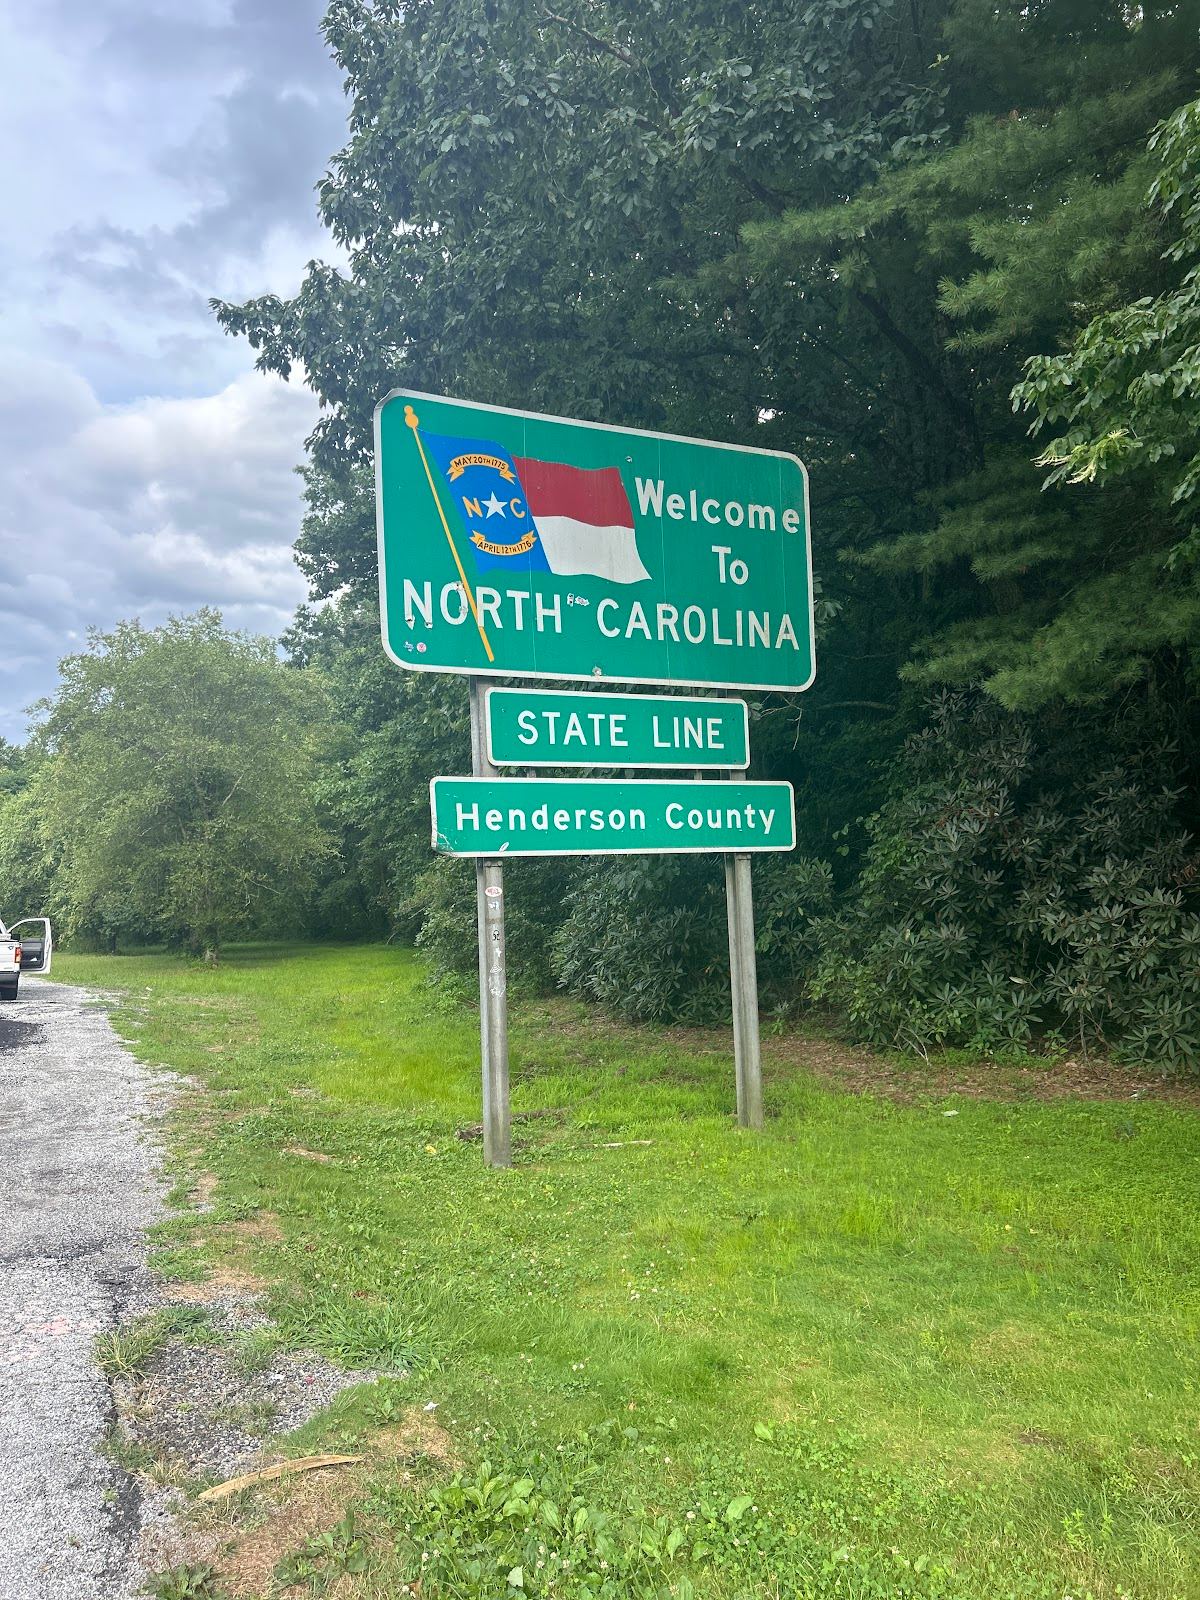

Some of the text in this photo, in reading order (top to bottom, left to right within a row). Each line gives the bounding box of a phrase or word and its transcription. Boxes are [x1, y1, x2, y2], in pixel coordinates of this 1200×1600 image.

[454, 456, 472, 468] MAY
[491, 458, 506, 470] 1775
[462, 496, 526, 518] N C
[634, 477, 801, 534] Welcome
[478, 542, 500, 554] APRIL
[516, 540, 532, 552] 1776
[711, 545, 749, 585] To
[403, 578, 800, 651] NORTH CAROLINA
[517, 710, 725, 749] STATE LINE
[455, 802, 775, 834] Henderson County
